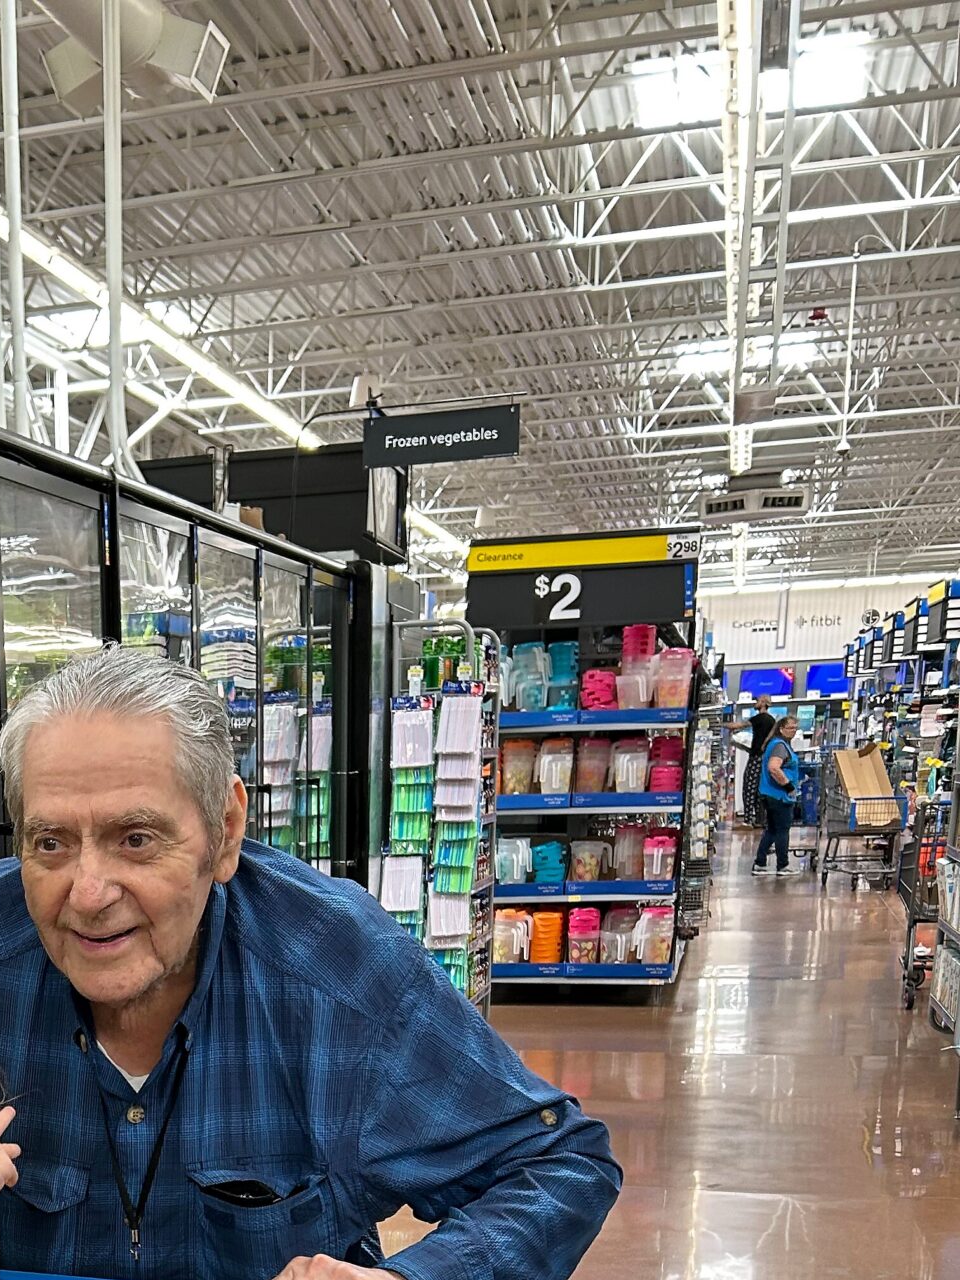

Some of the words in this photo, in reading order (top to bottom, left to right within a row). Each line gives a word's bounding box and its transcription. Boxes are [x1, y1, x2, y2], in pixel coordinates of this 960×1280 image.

[384, 435, 428, 449] Frozen
[429, 427, 499, 447] vegetables
[476, 552, 524, 563] Clearance
[534, 572, 582, 621] $2
[810, 615, 842, 628] fitbit
